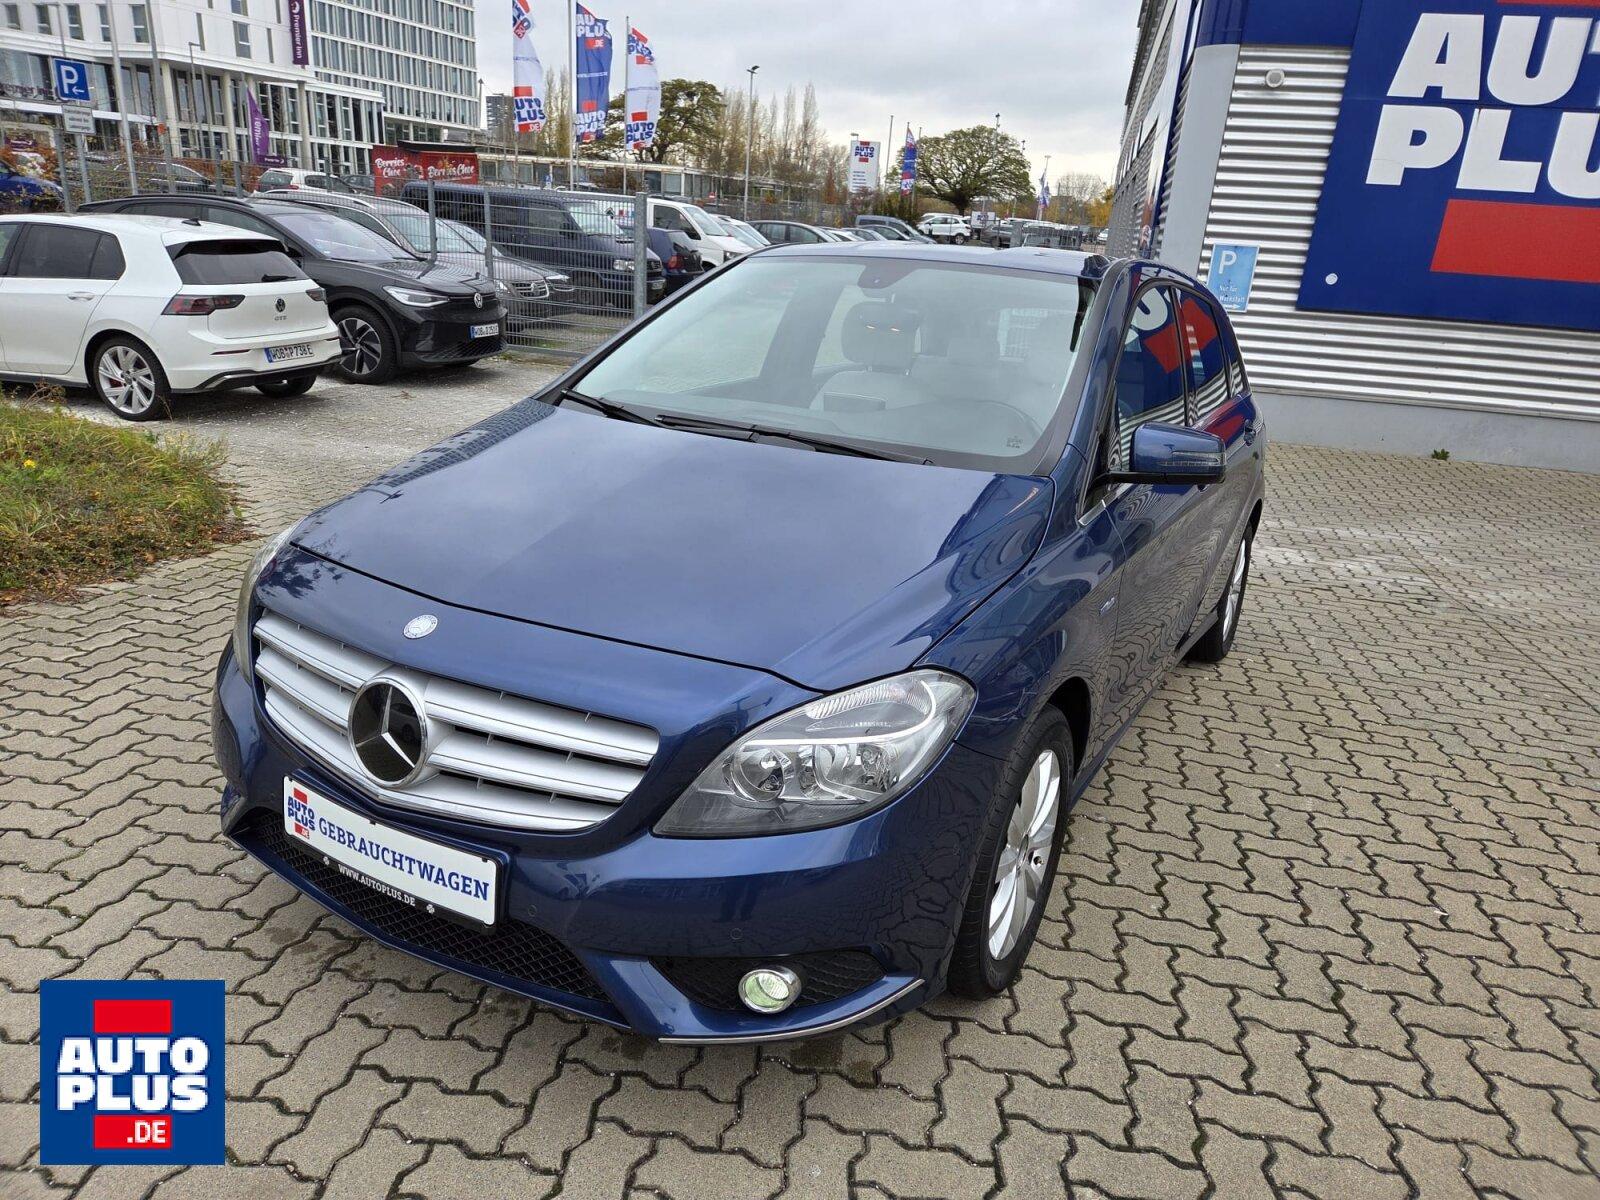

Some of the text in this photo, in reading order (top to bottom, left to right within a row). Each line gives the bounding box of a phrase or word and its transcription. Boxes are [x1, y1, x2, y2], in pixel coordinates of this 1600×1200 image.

[293, 14, 302, 46] Premier
[1386, 13, 1600, 106] AU
[61, 65, 78, 94] P
[626, 122, 655, 134] AUTO
[855, 145, 875, 153] AUTO
[1218, 250, 1237, 275] P
[270, 348, 286, 360] WOB
[287, 796, 315, 820] AUTO
[287, 807, 490, 901] PLUS GEBRAUCHTWAGEN
[338, 863, 416, 906] WWW.AUTOPLUS.DE
